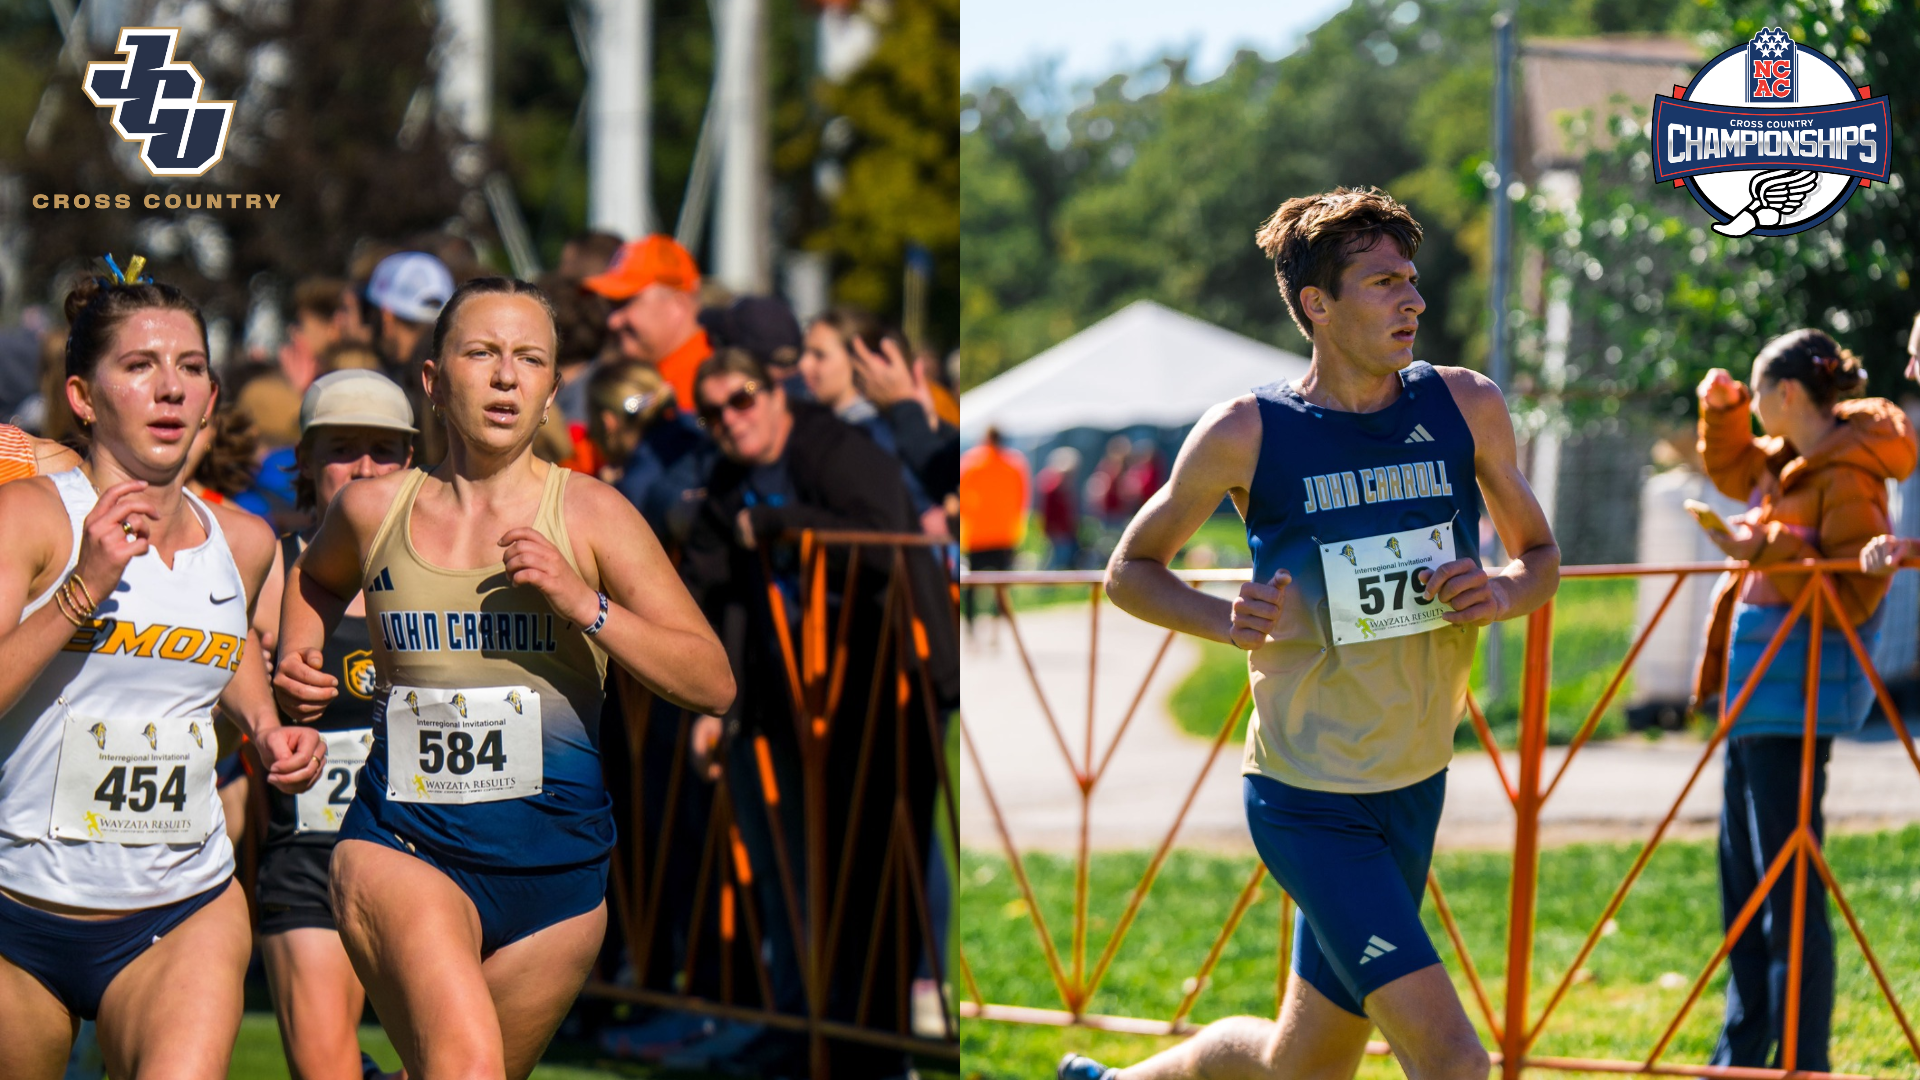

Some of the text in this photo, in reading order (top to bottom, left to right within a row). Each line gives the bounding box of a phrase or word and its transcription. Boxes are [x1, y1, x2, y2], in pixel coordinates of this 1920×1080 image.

[1303, 460, 1453, 514] JOHN CARROLL
[1354, 555, 1433, 574] Interregional Invitational
[1358, 566, 1434, 615] 579
[1370, 615, 1410, 628] WAYZATA
[1411, 607, 1444, 622] RESULTS
[379, 610, 441, 653] JOHN
[444, 610, 557, 653] CARROLL
[417, 718, 506, 729] Interregional Invitational
[98, 753, 190, 763] Interregional Invitational
[419, 729, 507, 775] 584
[94, 765, 187, 812] 454
[426, 779, 470, 790] WAYZATA
[473, 777, 516, 788] RESULTS
[100, 818, 191, 830] WAYZATA RESULTS
